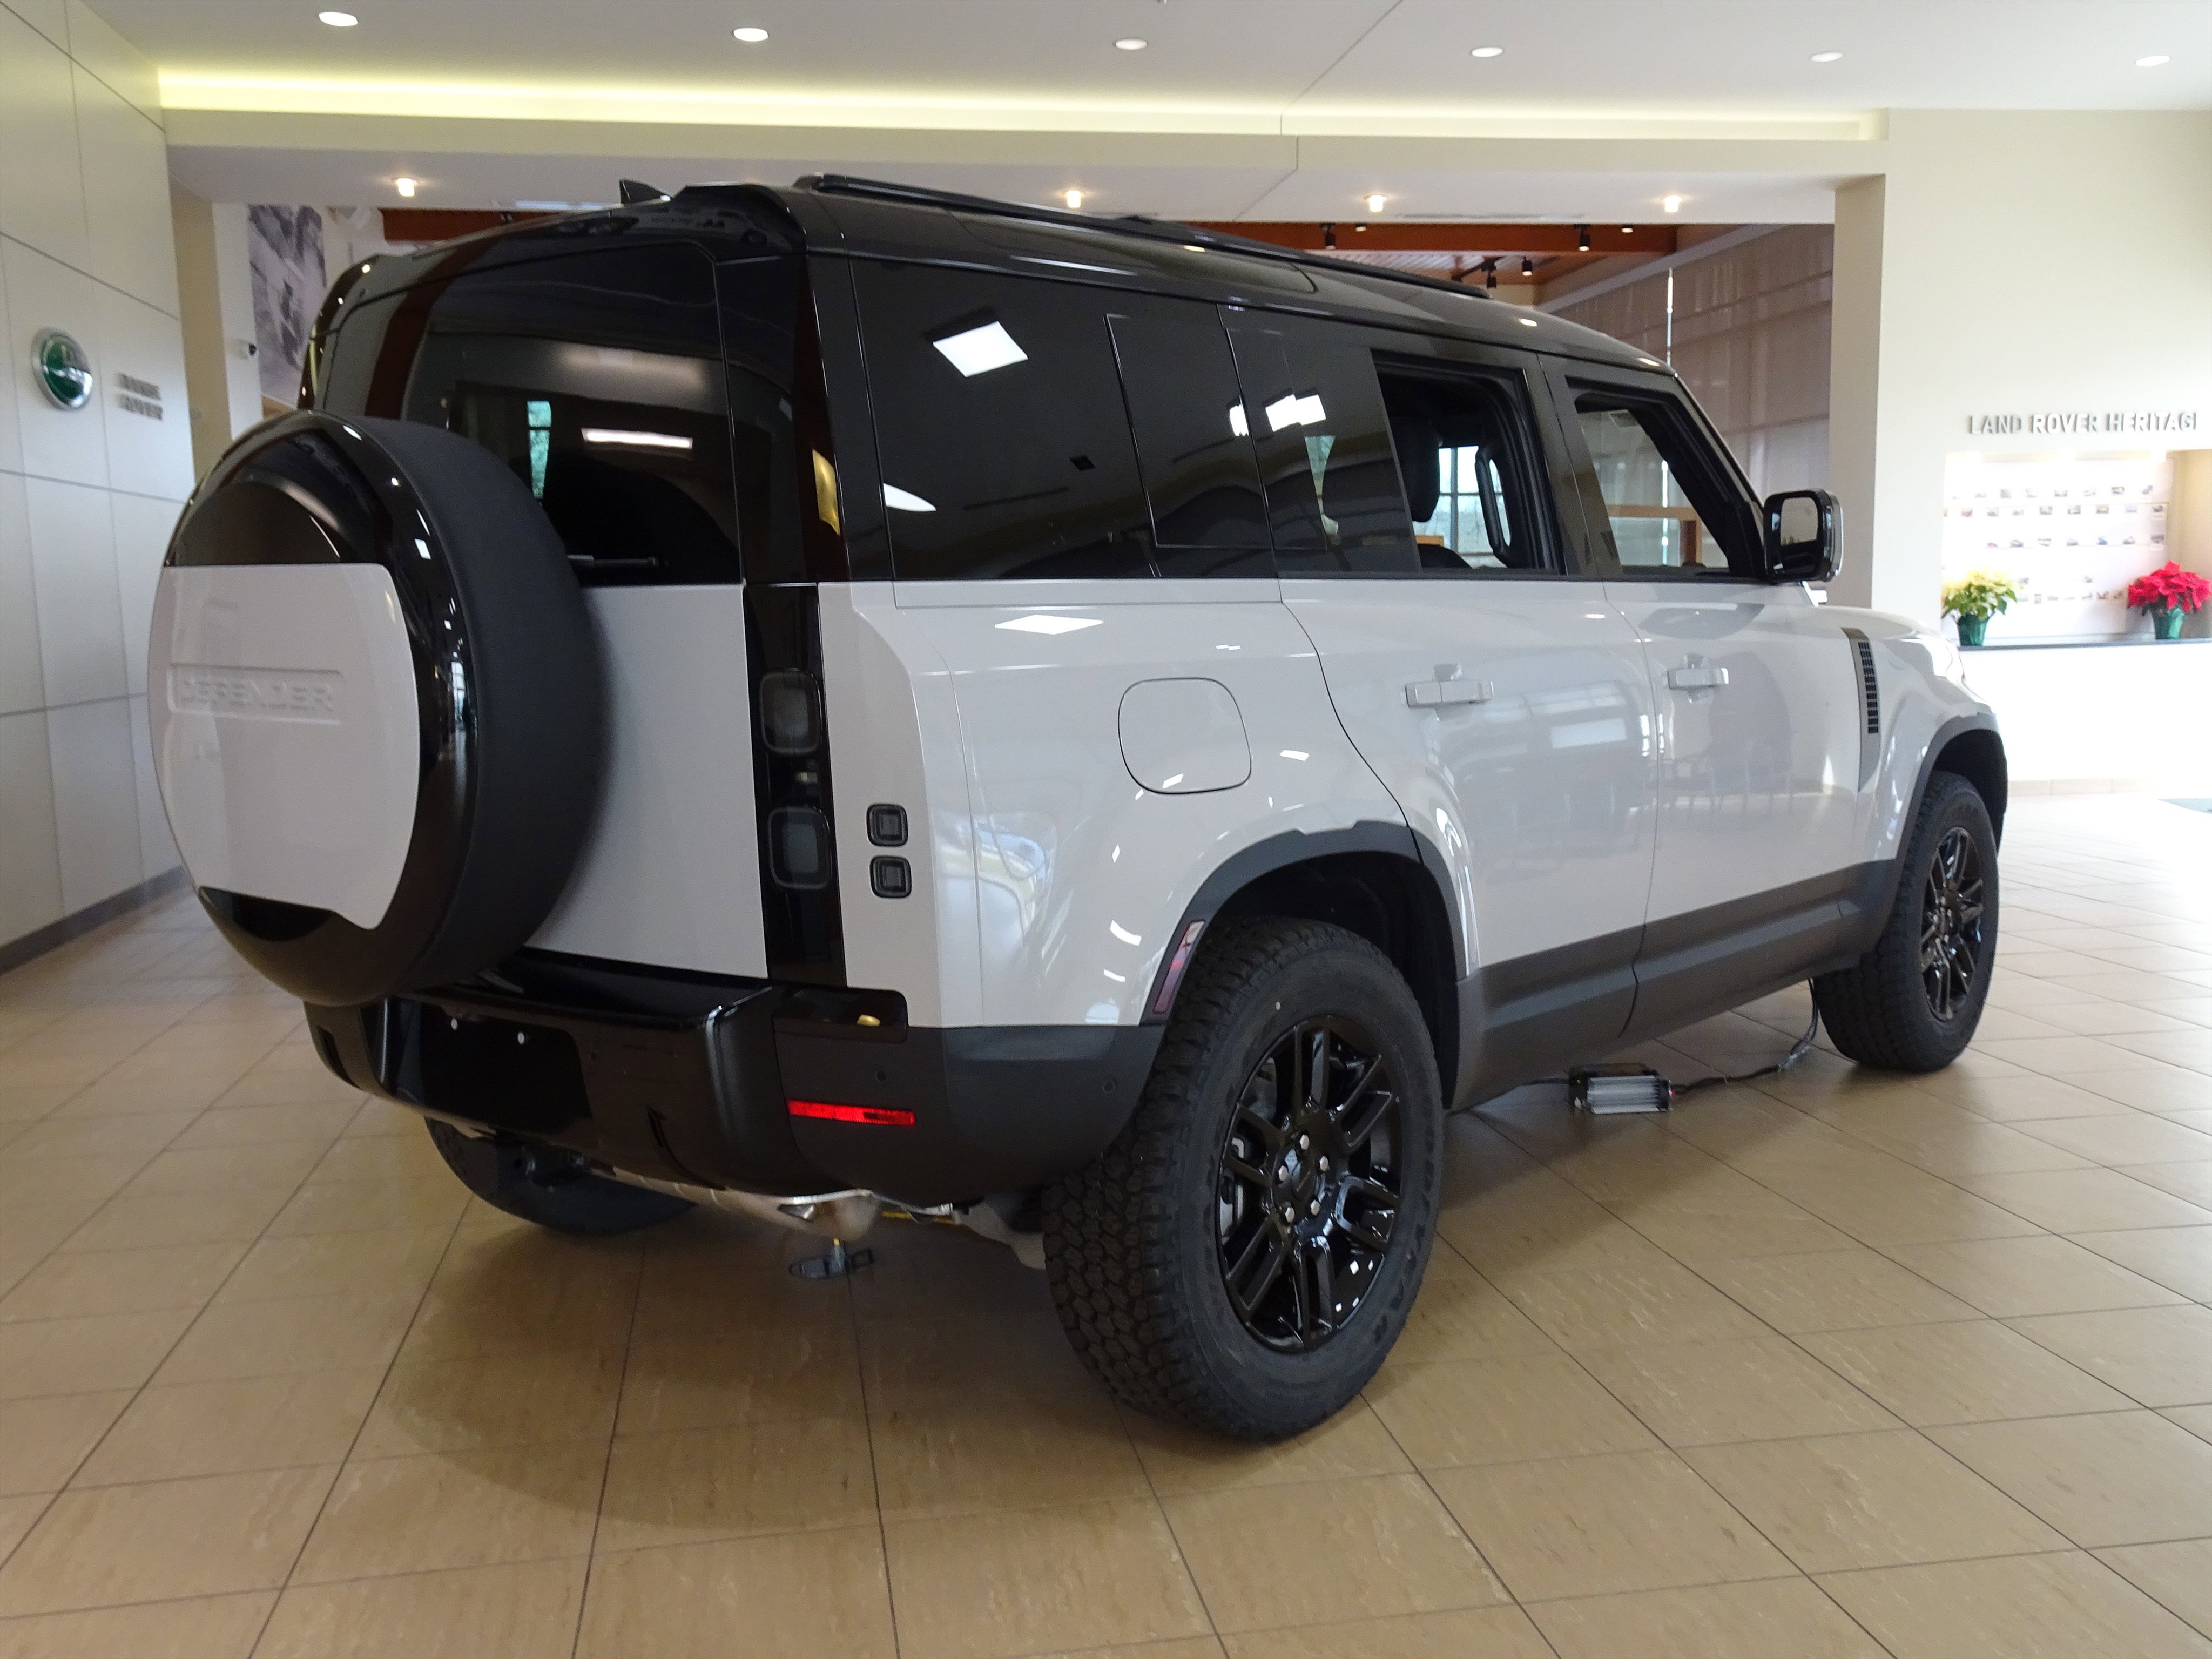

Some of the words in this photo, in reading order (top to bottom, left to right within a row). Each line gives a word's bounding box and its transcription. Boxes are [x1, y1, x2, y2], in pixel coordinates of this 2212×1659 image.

[1966, 414, 2022, 434] LAND
[2029, 413, 2100, 434] ROVER
[2105, 411, 2200, 433] HERITAG
